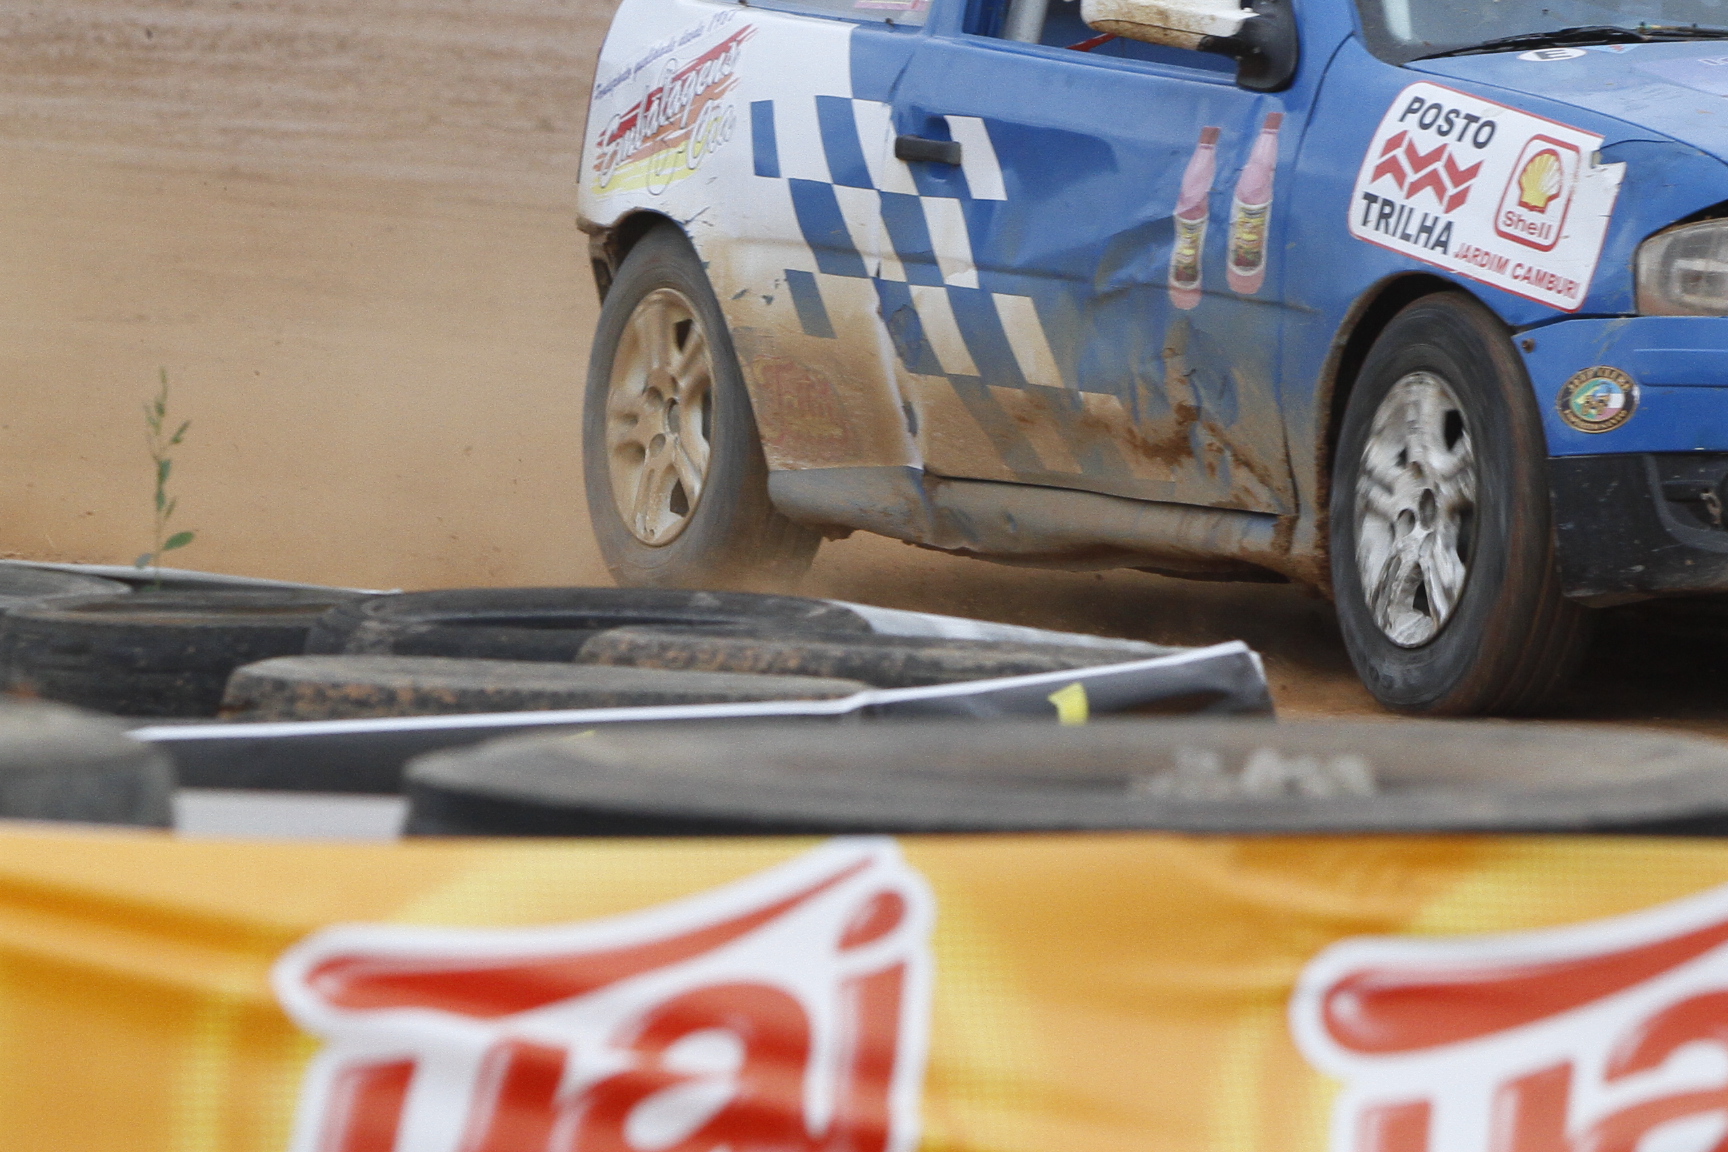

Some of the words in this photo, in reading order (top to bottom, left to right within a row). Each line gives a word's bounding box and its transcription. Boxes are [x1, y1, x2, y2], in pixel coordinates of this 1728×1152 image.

[1398, 96, 1496, 149] POSTO
[1361, 191, 1454, 255] TRILHA
[1453, 243, 1510, 273] JARDIM
[1511, 262, 1581, 300] CAMBURI
[1503, 210, 1553, 240] Shell
